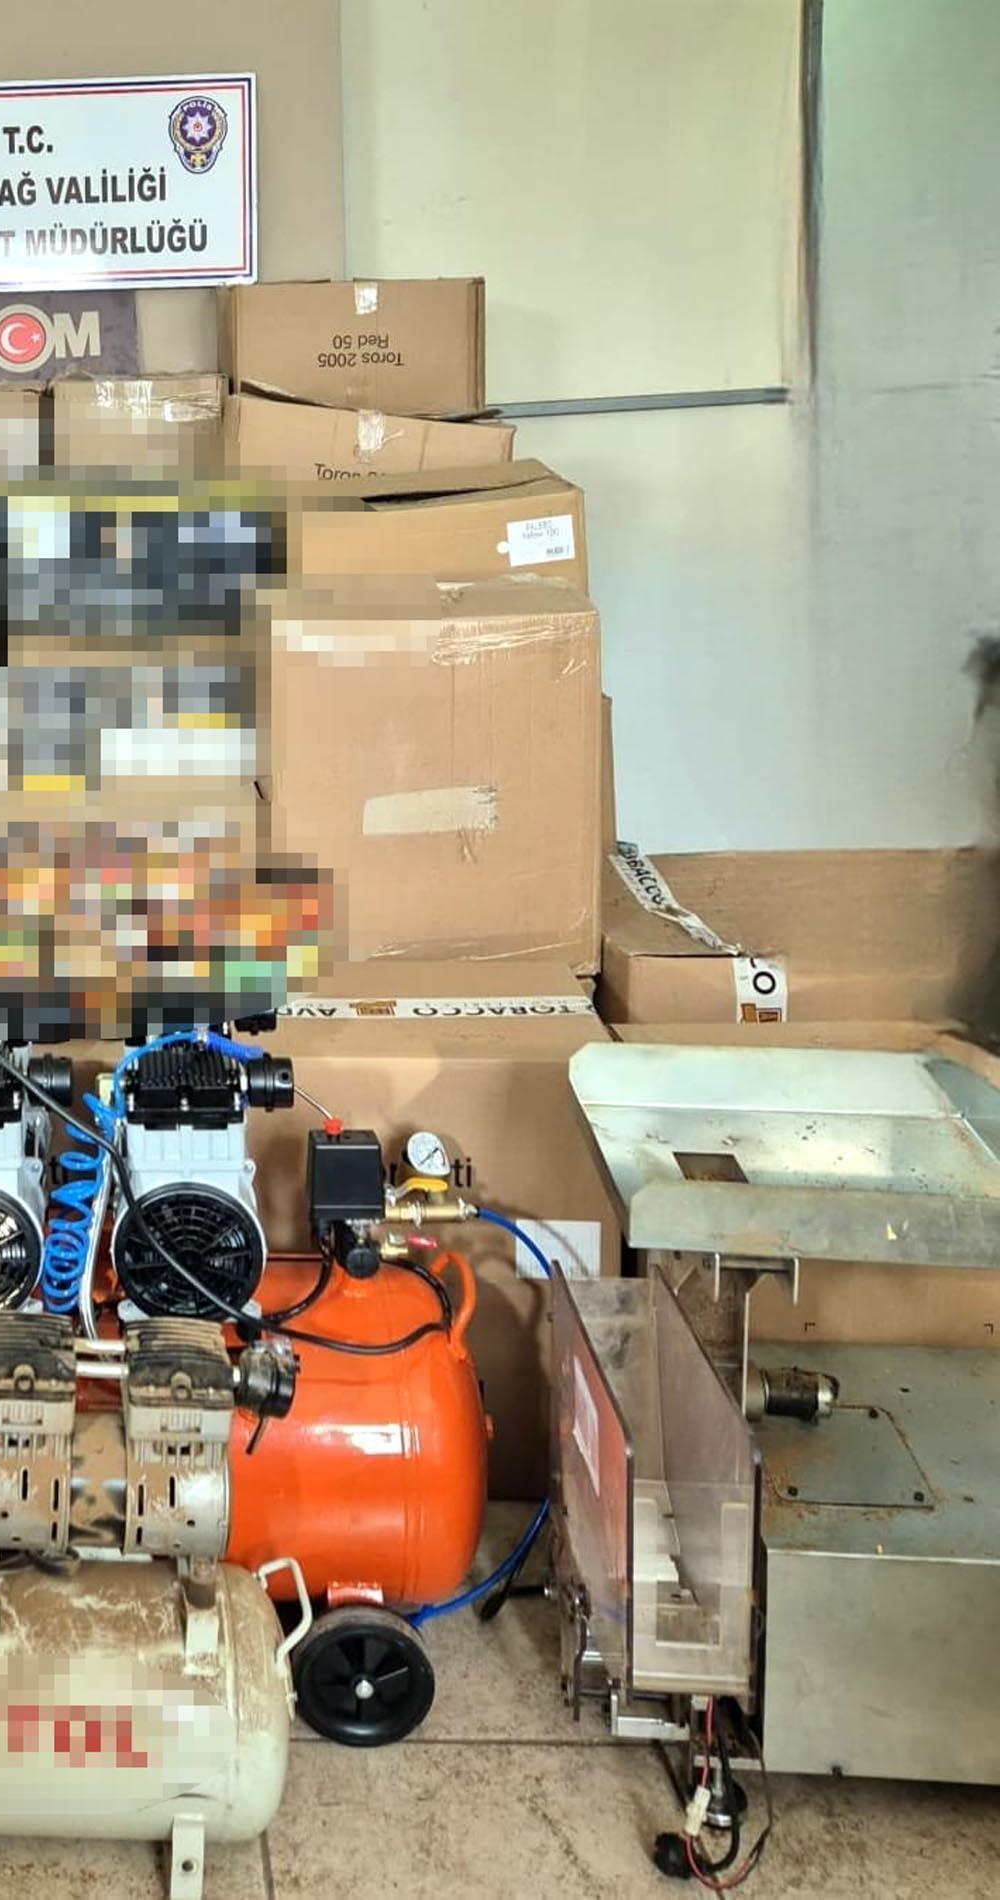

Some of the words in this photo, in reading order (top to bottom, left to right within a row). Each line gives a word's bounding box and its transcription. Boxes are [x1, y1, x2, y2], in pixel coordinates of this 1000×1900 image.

[3, 125, 53, 154] T.C.
[45, 167, 167, 205] VALİLİĞİ
[25, 218, 208, 256] MÜDÜRLÜĞÜ
[332, 334, 353, 349] 50
[358, 332, 389, 349] Red
[317, 352, 356, 367] 2005
[361, 351, 405, 366] Toros
